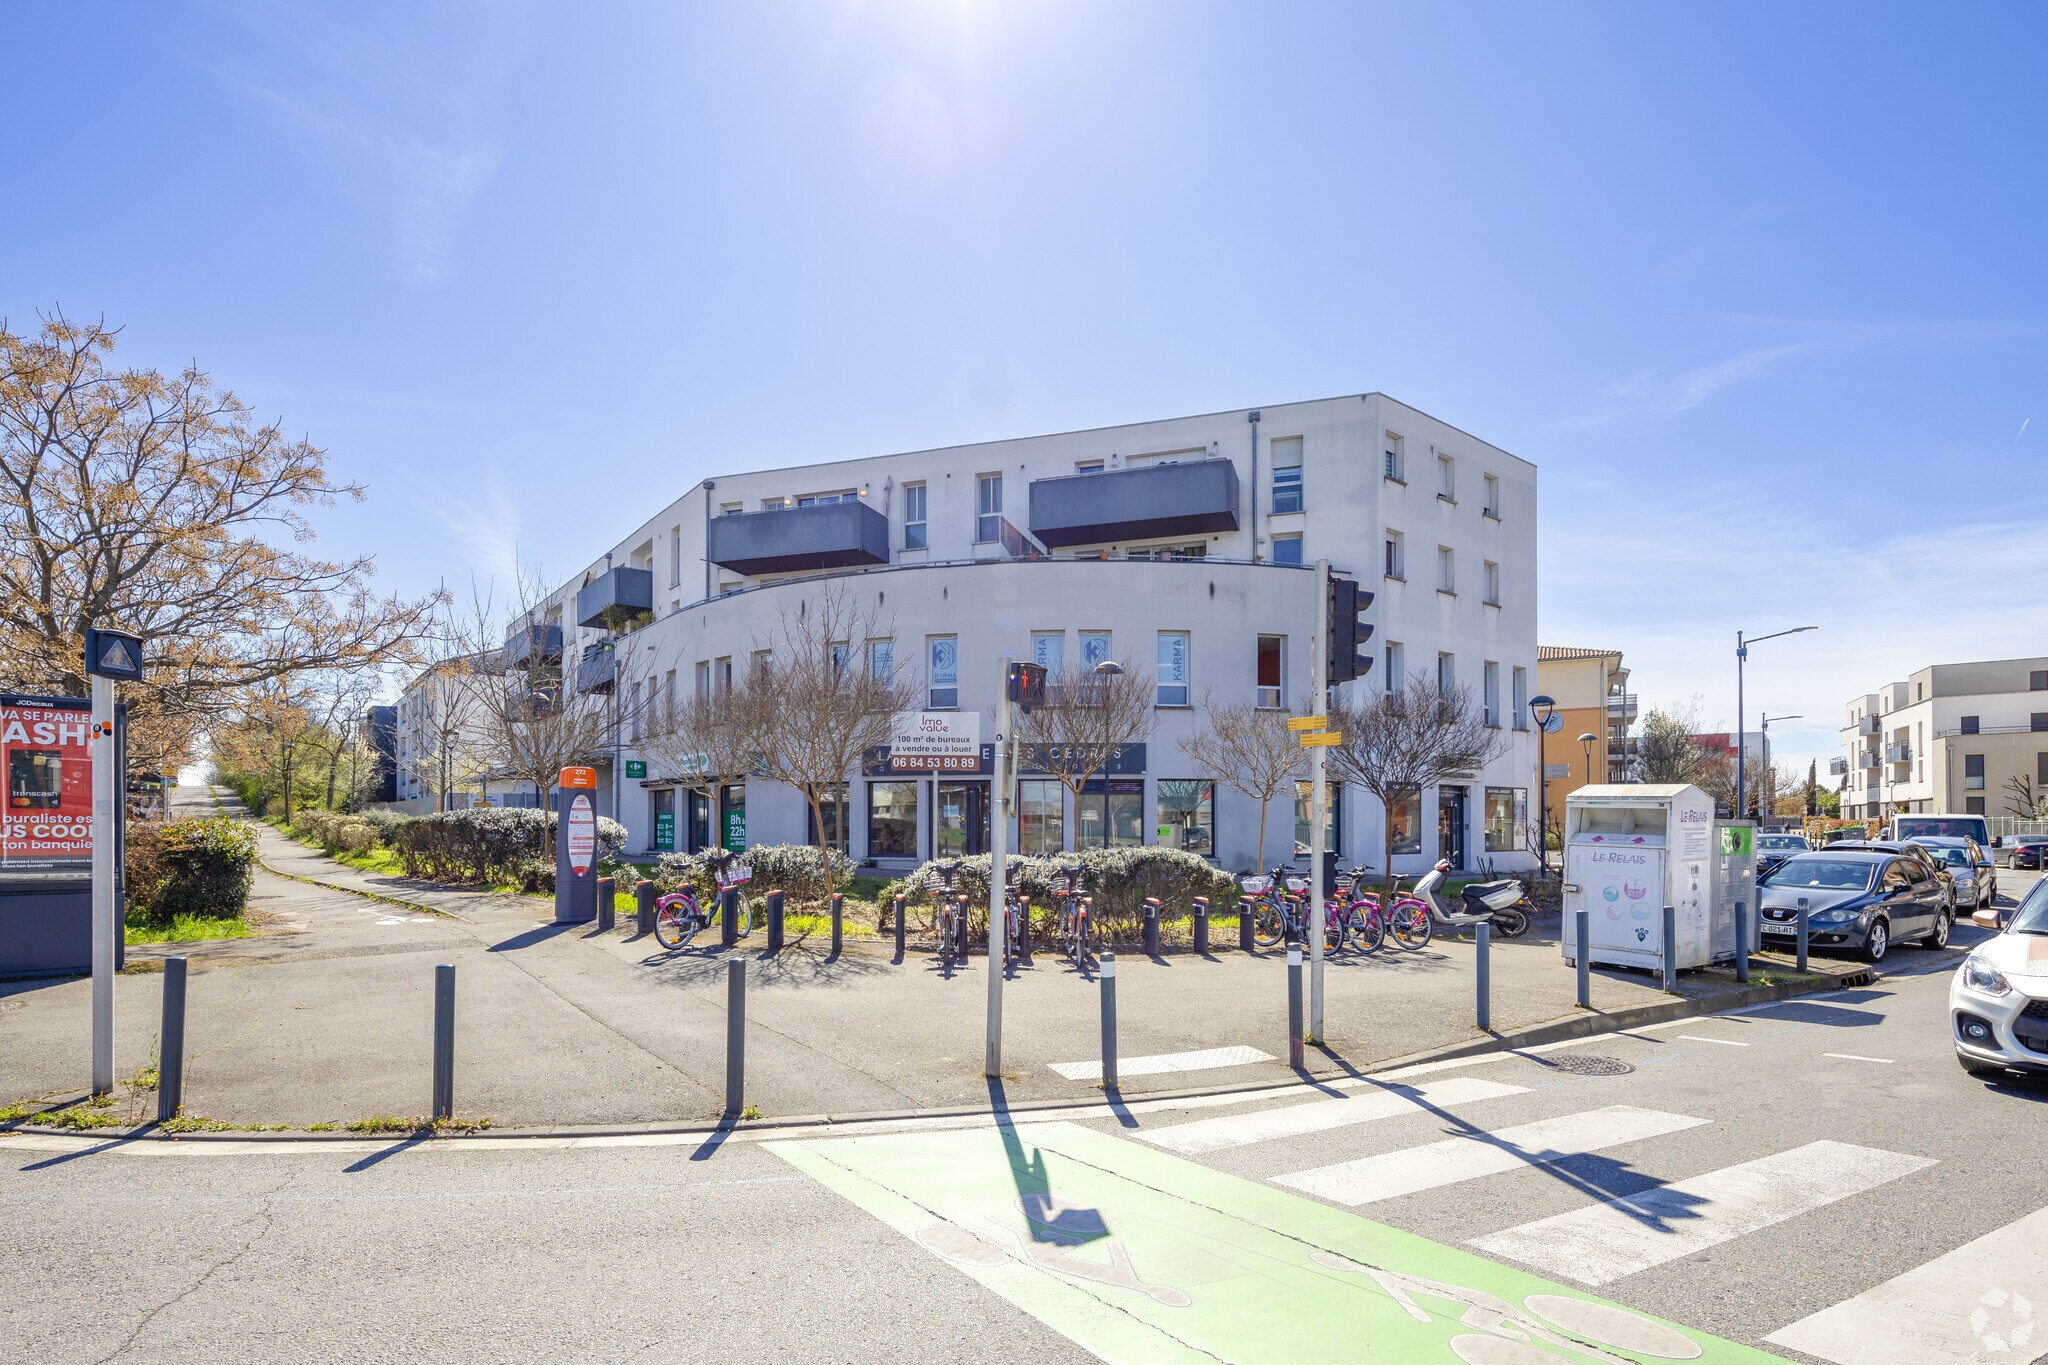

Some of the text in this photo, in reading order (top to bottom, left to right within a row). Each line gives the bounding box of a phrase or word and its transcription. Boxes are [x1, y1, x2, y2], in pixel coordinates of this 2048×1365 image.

[1173, 639, 1182, 681] KARMA
[23, 711, 41, 721] SE
[44, 712, 92, 723] PARLE
[2, 721, 85, 746] ASH
[893, 757, 975, 768] 06 84 53 80 89
[3, 813, 72, 823] buraliste
[730, 815, 741, 825] 8h
[0, 824, 27, 838] US
[730, 826, 745, 837] 22h
[2, 840, 93, 851] ton banquie
[1592, 852, 1647, 865] LE RELAIS
